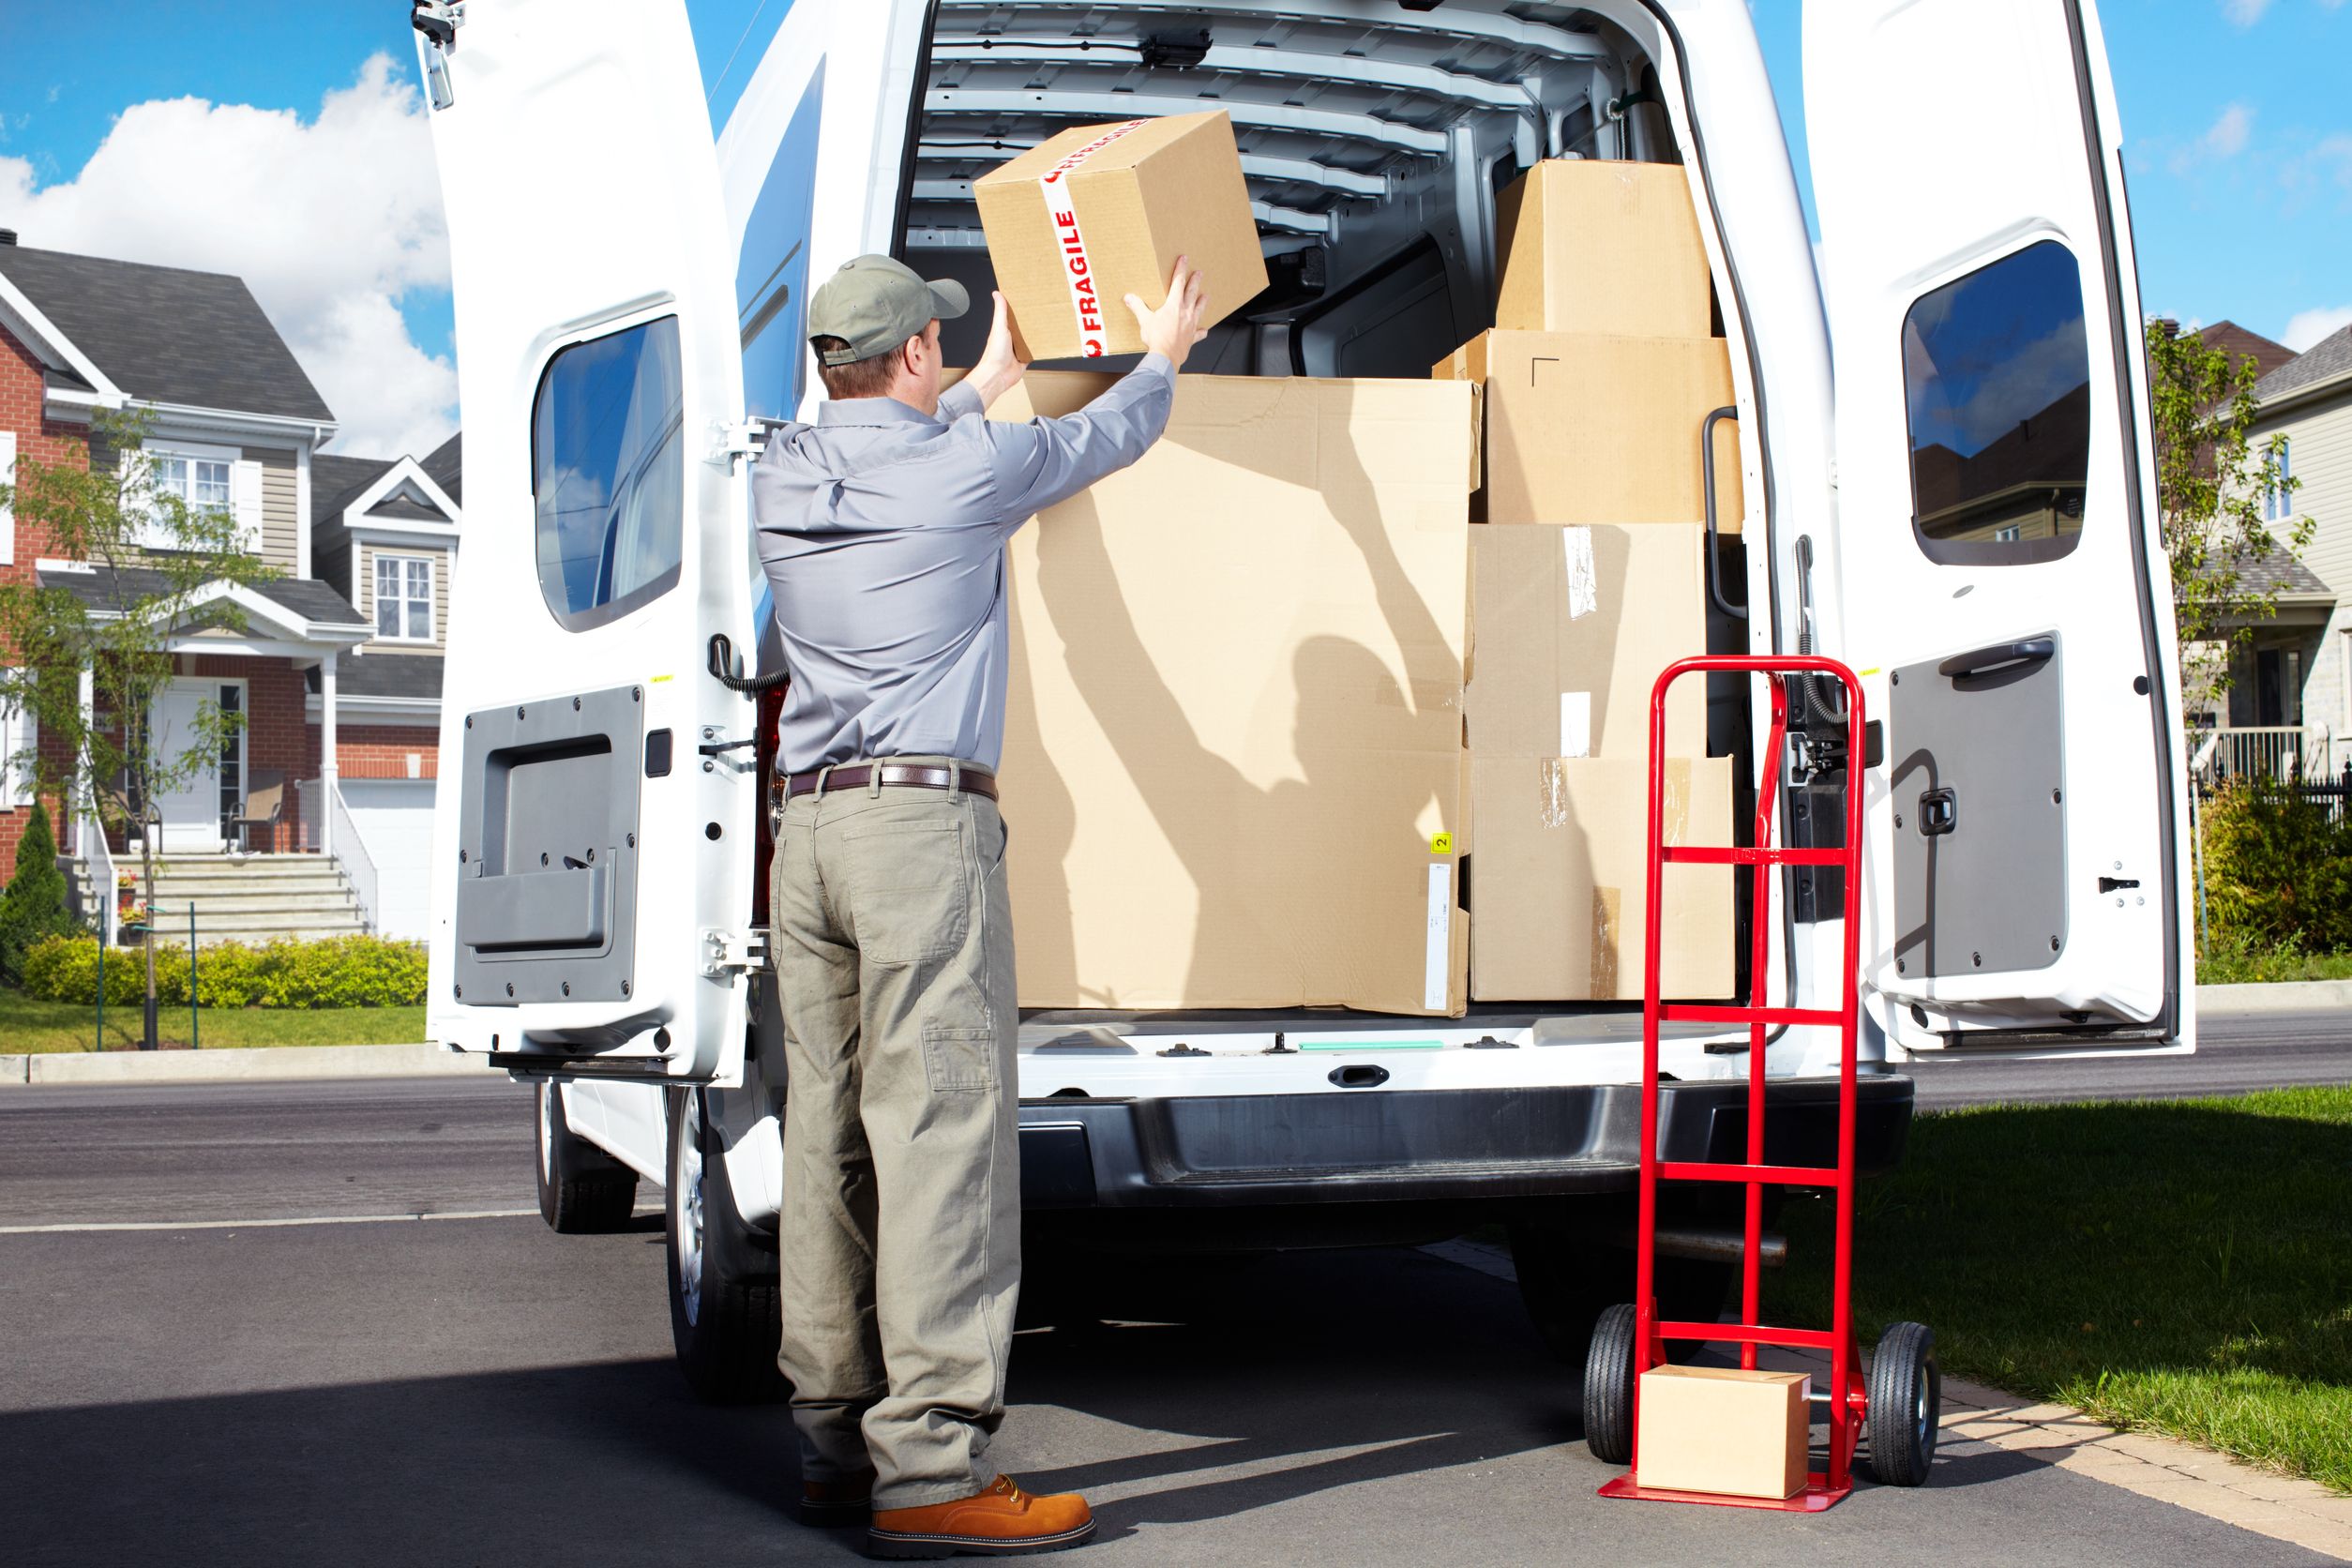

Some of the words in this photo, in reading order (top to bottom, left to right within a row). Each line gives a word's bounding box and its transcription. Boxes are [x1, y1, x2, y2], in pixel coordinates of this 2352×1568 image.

[1069, 119, 1148, 158] FRAGILE
[1056, 210, 1102, 332] FRAGILE
[1436, 838, 1448, 847] 2
